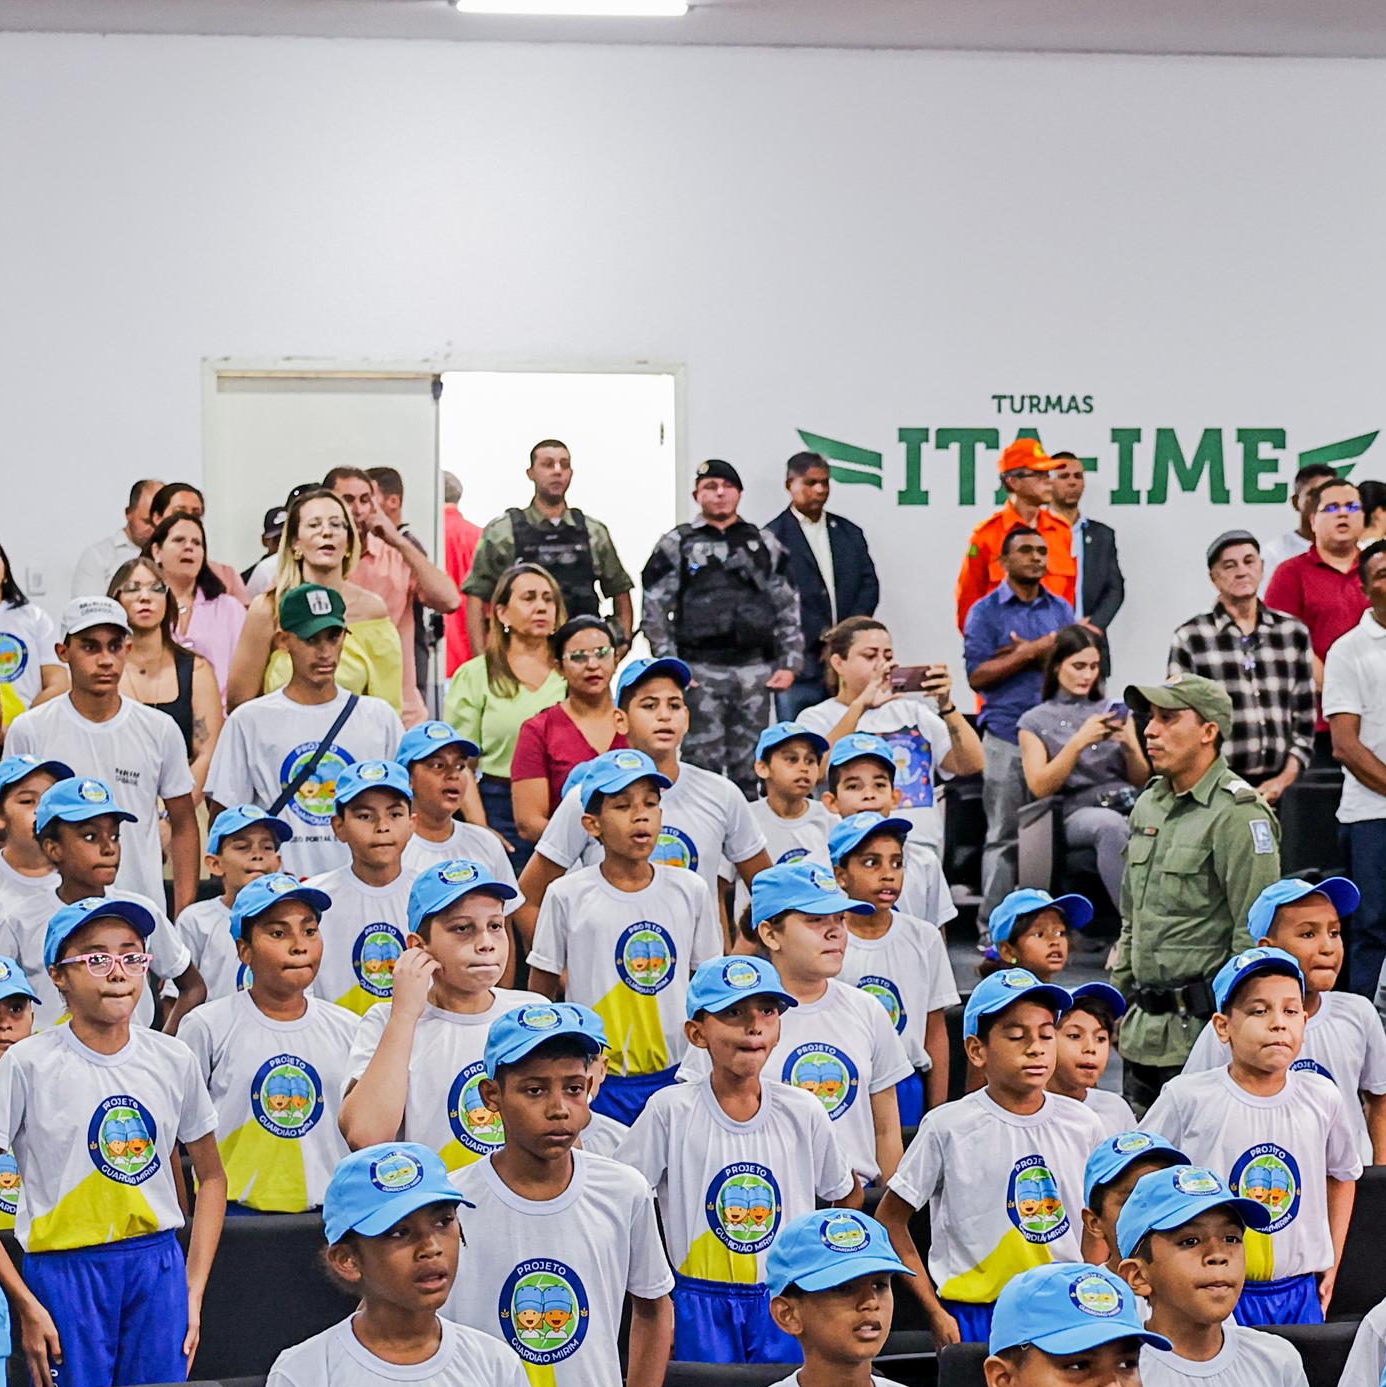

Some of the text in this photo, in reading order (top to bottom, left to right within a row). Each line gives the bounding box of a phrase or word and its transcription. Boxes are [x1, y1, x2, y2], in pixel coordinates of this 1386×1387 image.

[991, 395, 1094, 415] TURMAS
[796, 1043, 836, 1056] PROJETO
[725, 1164, 767, 1178] PROJETO
[1046, 1221, 1070, 1241] MIRIM
[515, 1260, 567, 1276] PROJETO
[510, 1336, 579, 1363] GUARDIÃO MIRIM
